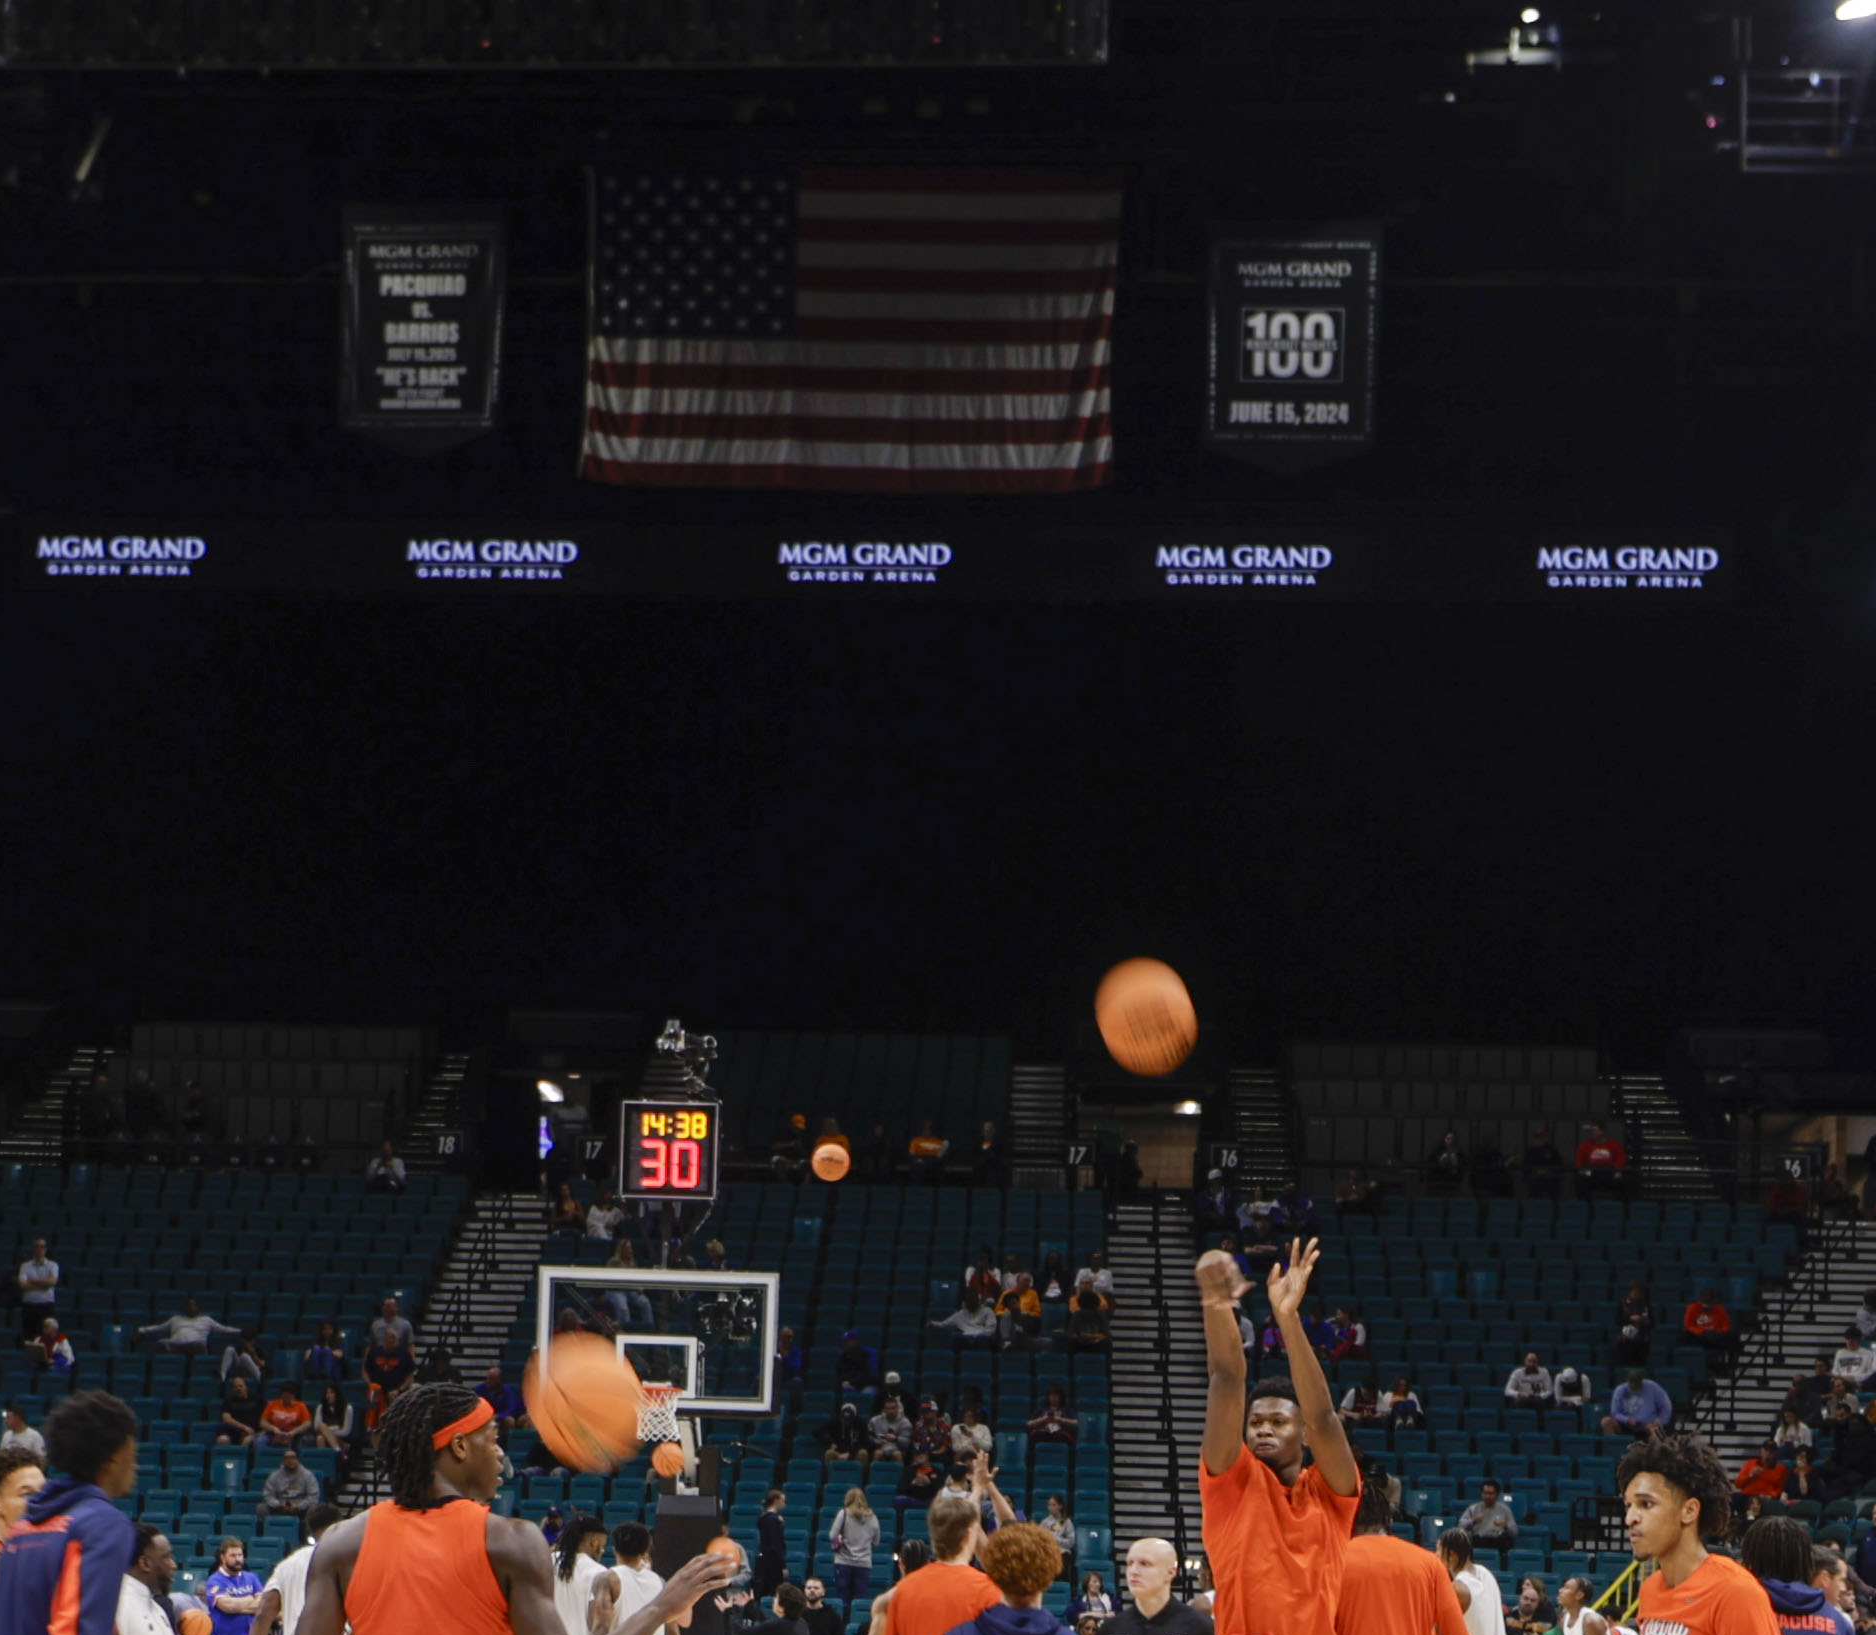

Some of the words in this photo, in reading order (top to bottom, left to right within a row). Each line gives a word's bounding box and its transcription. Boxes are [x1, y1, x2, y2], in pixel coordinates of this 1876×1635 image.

[1237, 263, 1283, 276] MGM
[1285, 261, 1353, 277] GRAND
[379, 274, 466, 297] PACQUIAO
[384, 322, 460, 343] BARRIOS
[1245, 311, 1336, 379] 100
[1229, 401, 1273, 424] JUNE
[1276, 402, 1301, 426] 15,
[1304, 402, 1349, 424] 2024
[38, 536, 105, 559] MGM
[109, 536, 207, 560] GRAND
[407, 540, 475, 562] MGM
[480, 540, 578, 563] GRAND
[778, 542, 848, 565] MGM
[853, 542, 951, 566] GRAND
[1155, 545, 1226, 568] MGM
[1231, 545, 1332, 569] GRAND
[1537, 546, 1610, 570] MGM
[1615, 546, 1719, 571] GRAND
[47, 564, 121, 576] GARDEN
[129, 564, 191, 576] ARENA
[417, 567, 492, 579] GARDEN
[500, 567, 562, 579] ARENA
[788, 570, 864, 582] GARDEN
[873, 570, 936, 582] ARENA
[1166, 573, 1243, 585] GARDEN
[1252, 573, 1316, 585] ARENA
[1546, 576, 1627, 588] GARDEN
[1636, 576, 1703, 588] ARENA
[641, 1110, 708, 1139] 14:38
[437, 1135, 457, 1155] 18
[584, 1140, 604, 1160] 17
[1067, 1145, 1088, 1165] 17
[639, 1139, 701, 1189] 30
[1220, 1148, 1238, 1168] 16
